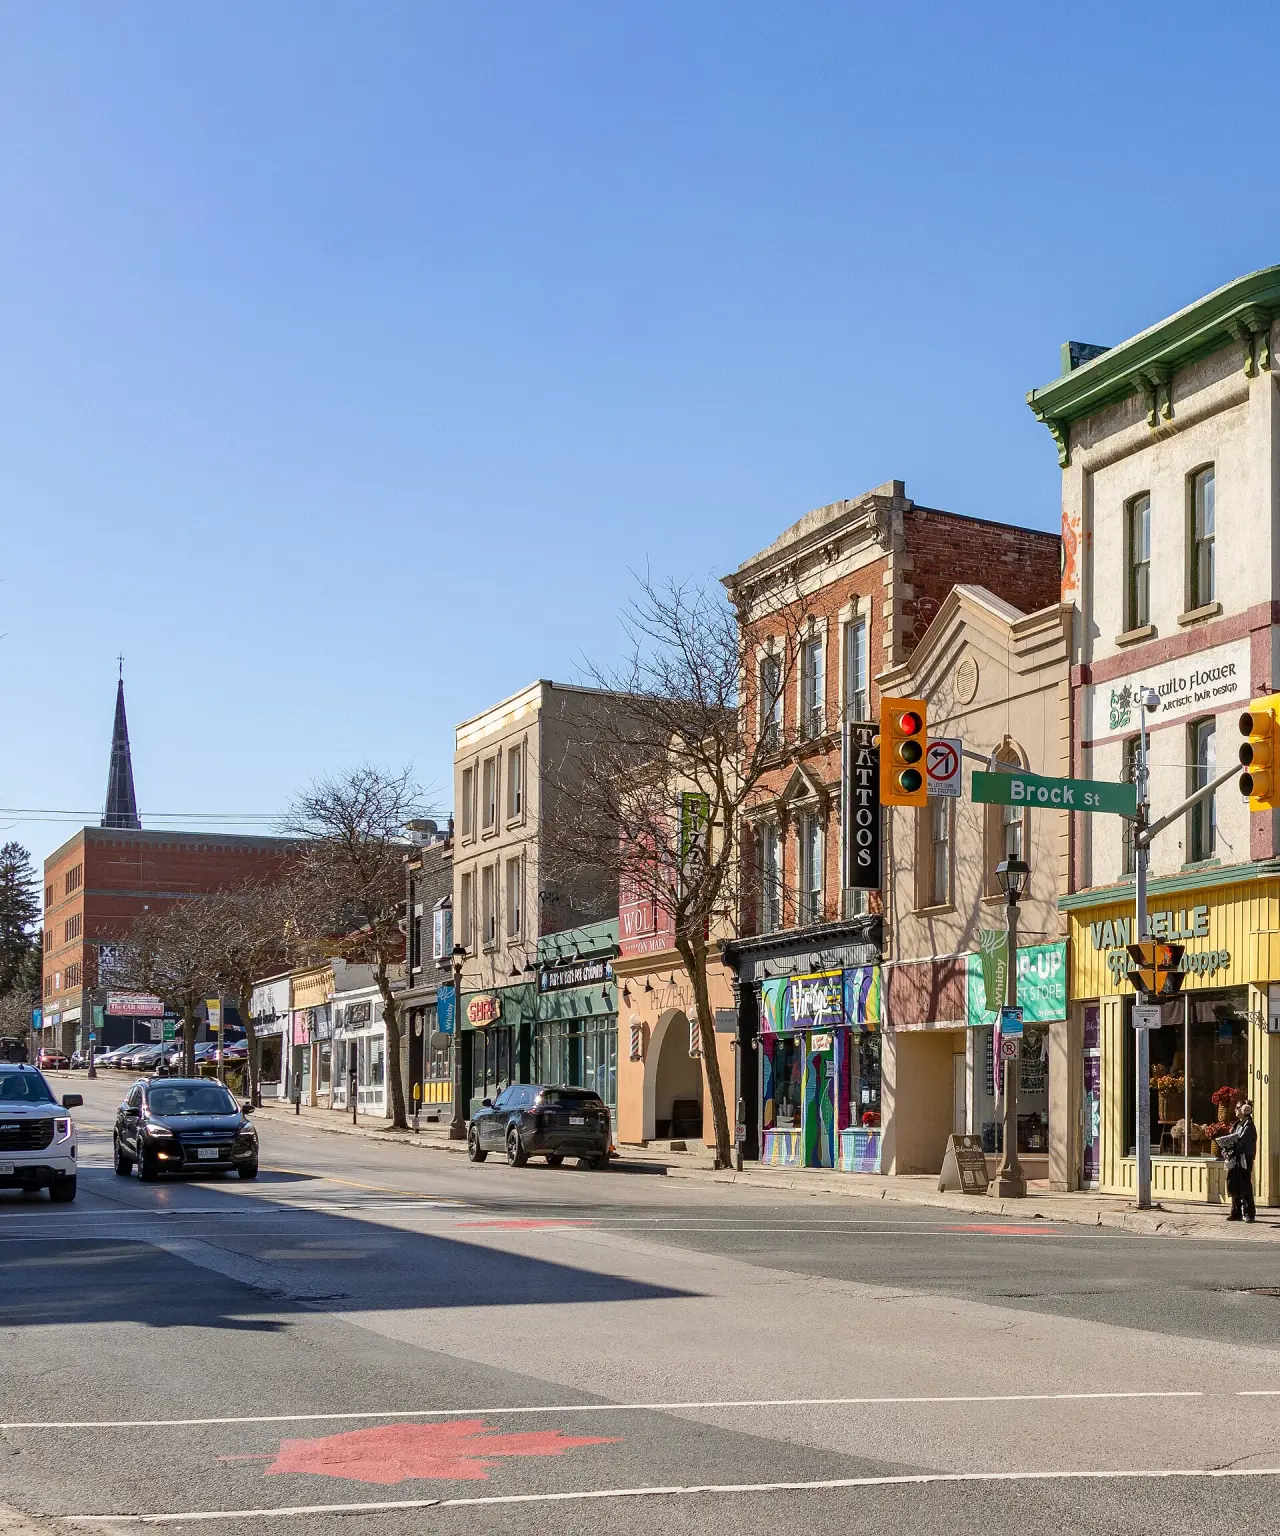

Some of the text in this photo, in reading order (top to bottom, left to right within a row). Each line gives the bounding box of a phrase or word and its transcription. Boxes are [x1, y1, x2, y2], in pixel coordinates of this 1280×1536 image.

[855, 728, 874, 867] TATTOOS
[1010, 780, 1100, 806] Brock St
[1090, 917, 1131, 950] VAN
[994, 958, 1006, 1006] Whitby
[1030, 983, 1062, 1001] STORE
[650, 984, 696, 1011] PIZZERIA
[445, 1003, 455, 1030] Whitby
